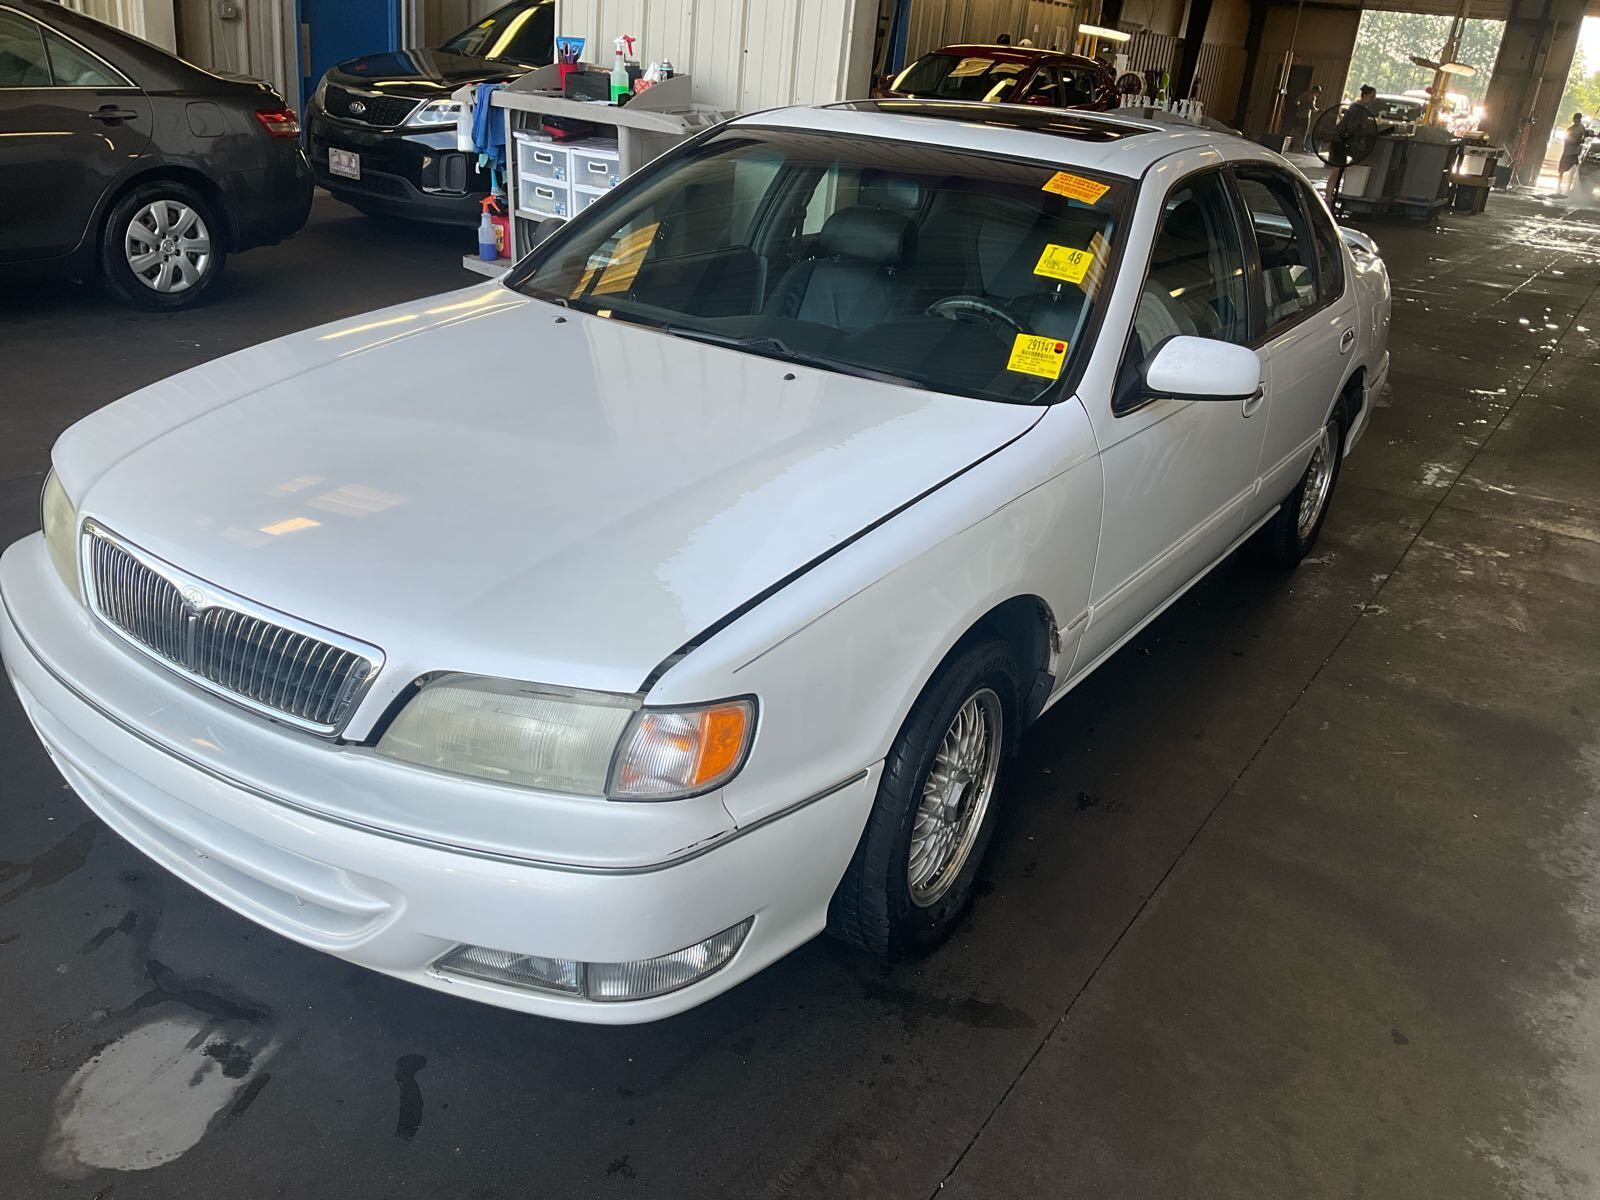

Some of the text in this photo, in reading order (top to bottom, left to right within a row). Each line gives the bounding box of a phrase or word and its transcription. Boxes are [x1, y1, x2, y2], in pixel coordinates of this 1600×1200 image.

[1050, 247, 1083, 265] T 48
[1027, 338, 1055, 353] 291147
